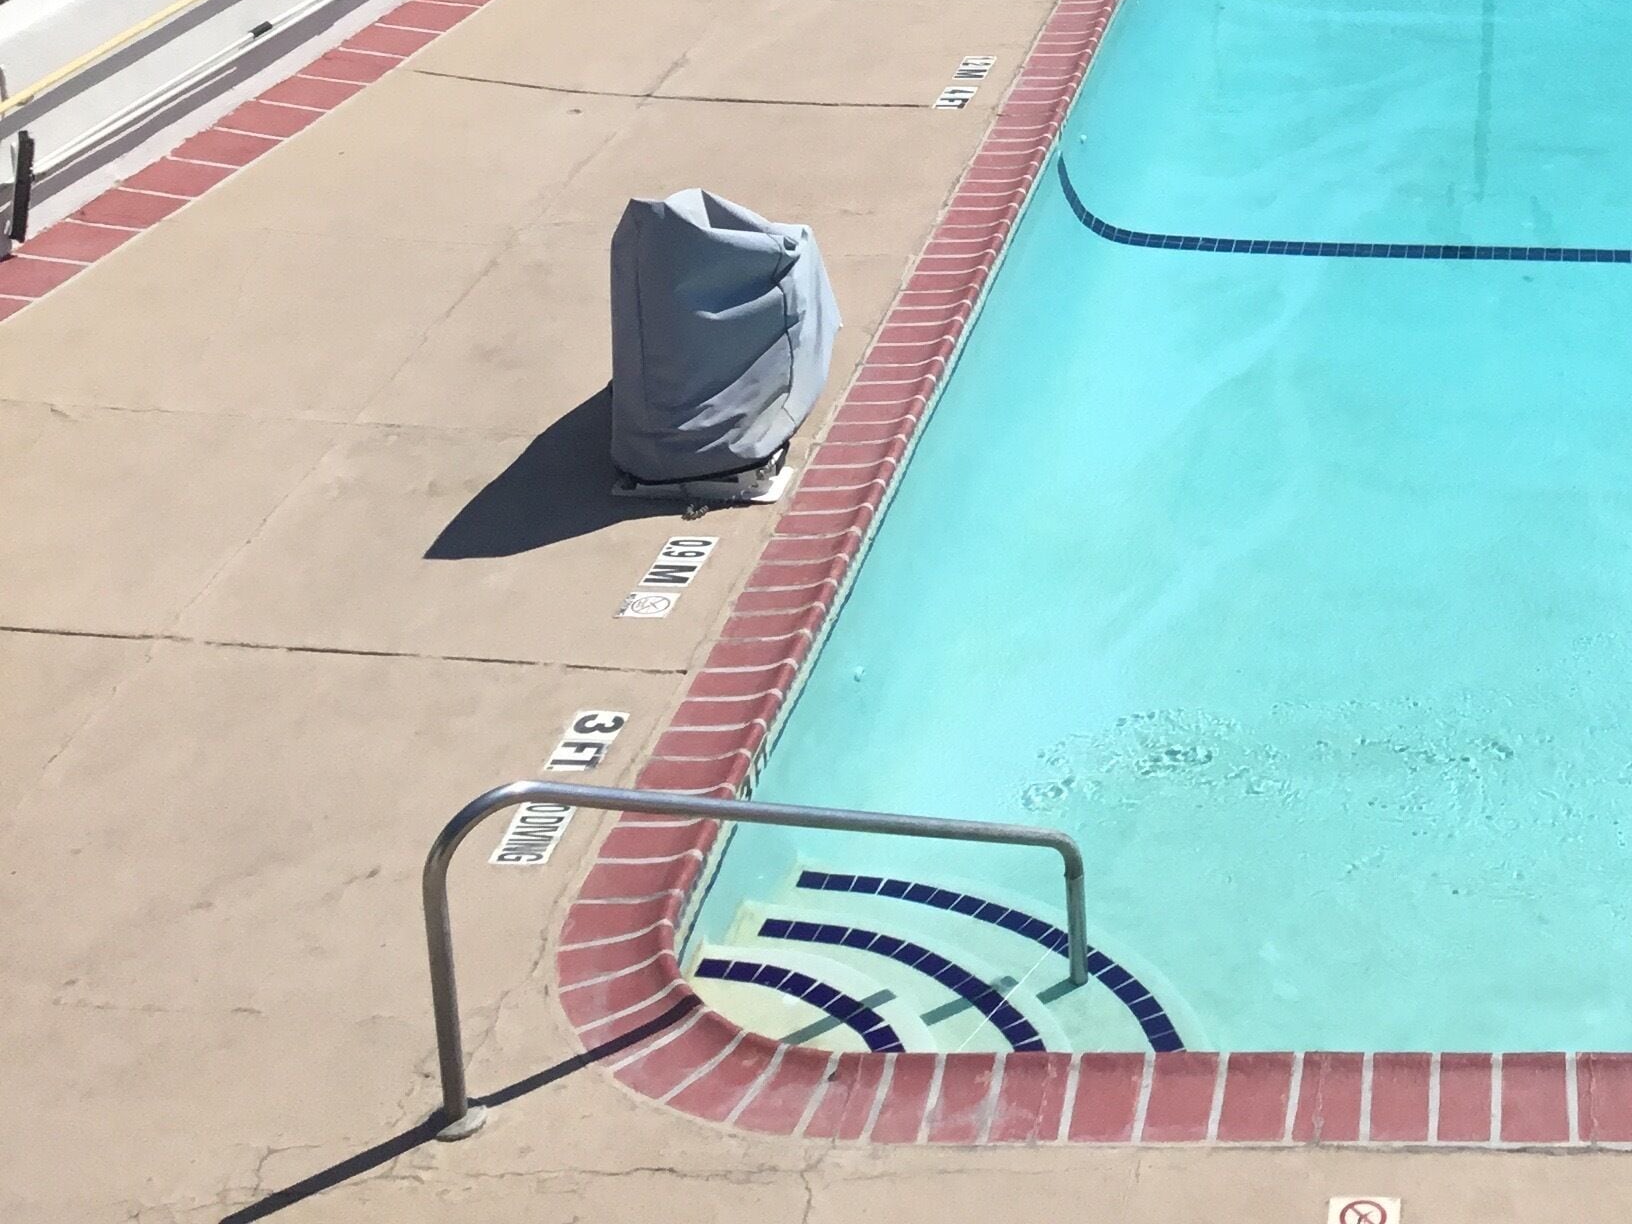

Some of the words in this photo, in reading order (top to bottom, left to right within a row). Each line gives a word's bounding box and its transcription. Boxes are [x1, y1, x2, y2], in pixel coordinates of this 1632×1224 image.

[953, 69, 988, 79] M
[935, 97, 970, 109] FT
[660, 539, 713, 558] 0.9
[642, 563, 699, 585] M
[572, 713, 625, 735] 3
[496, 816, 565, 862] DIVING
